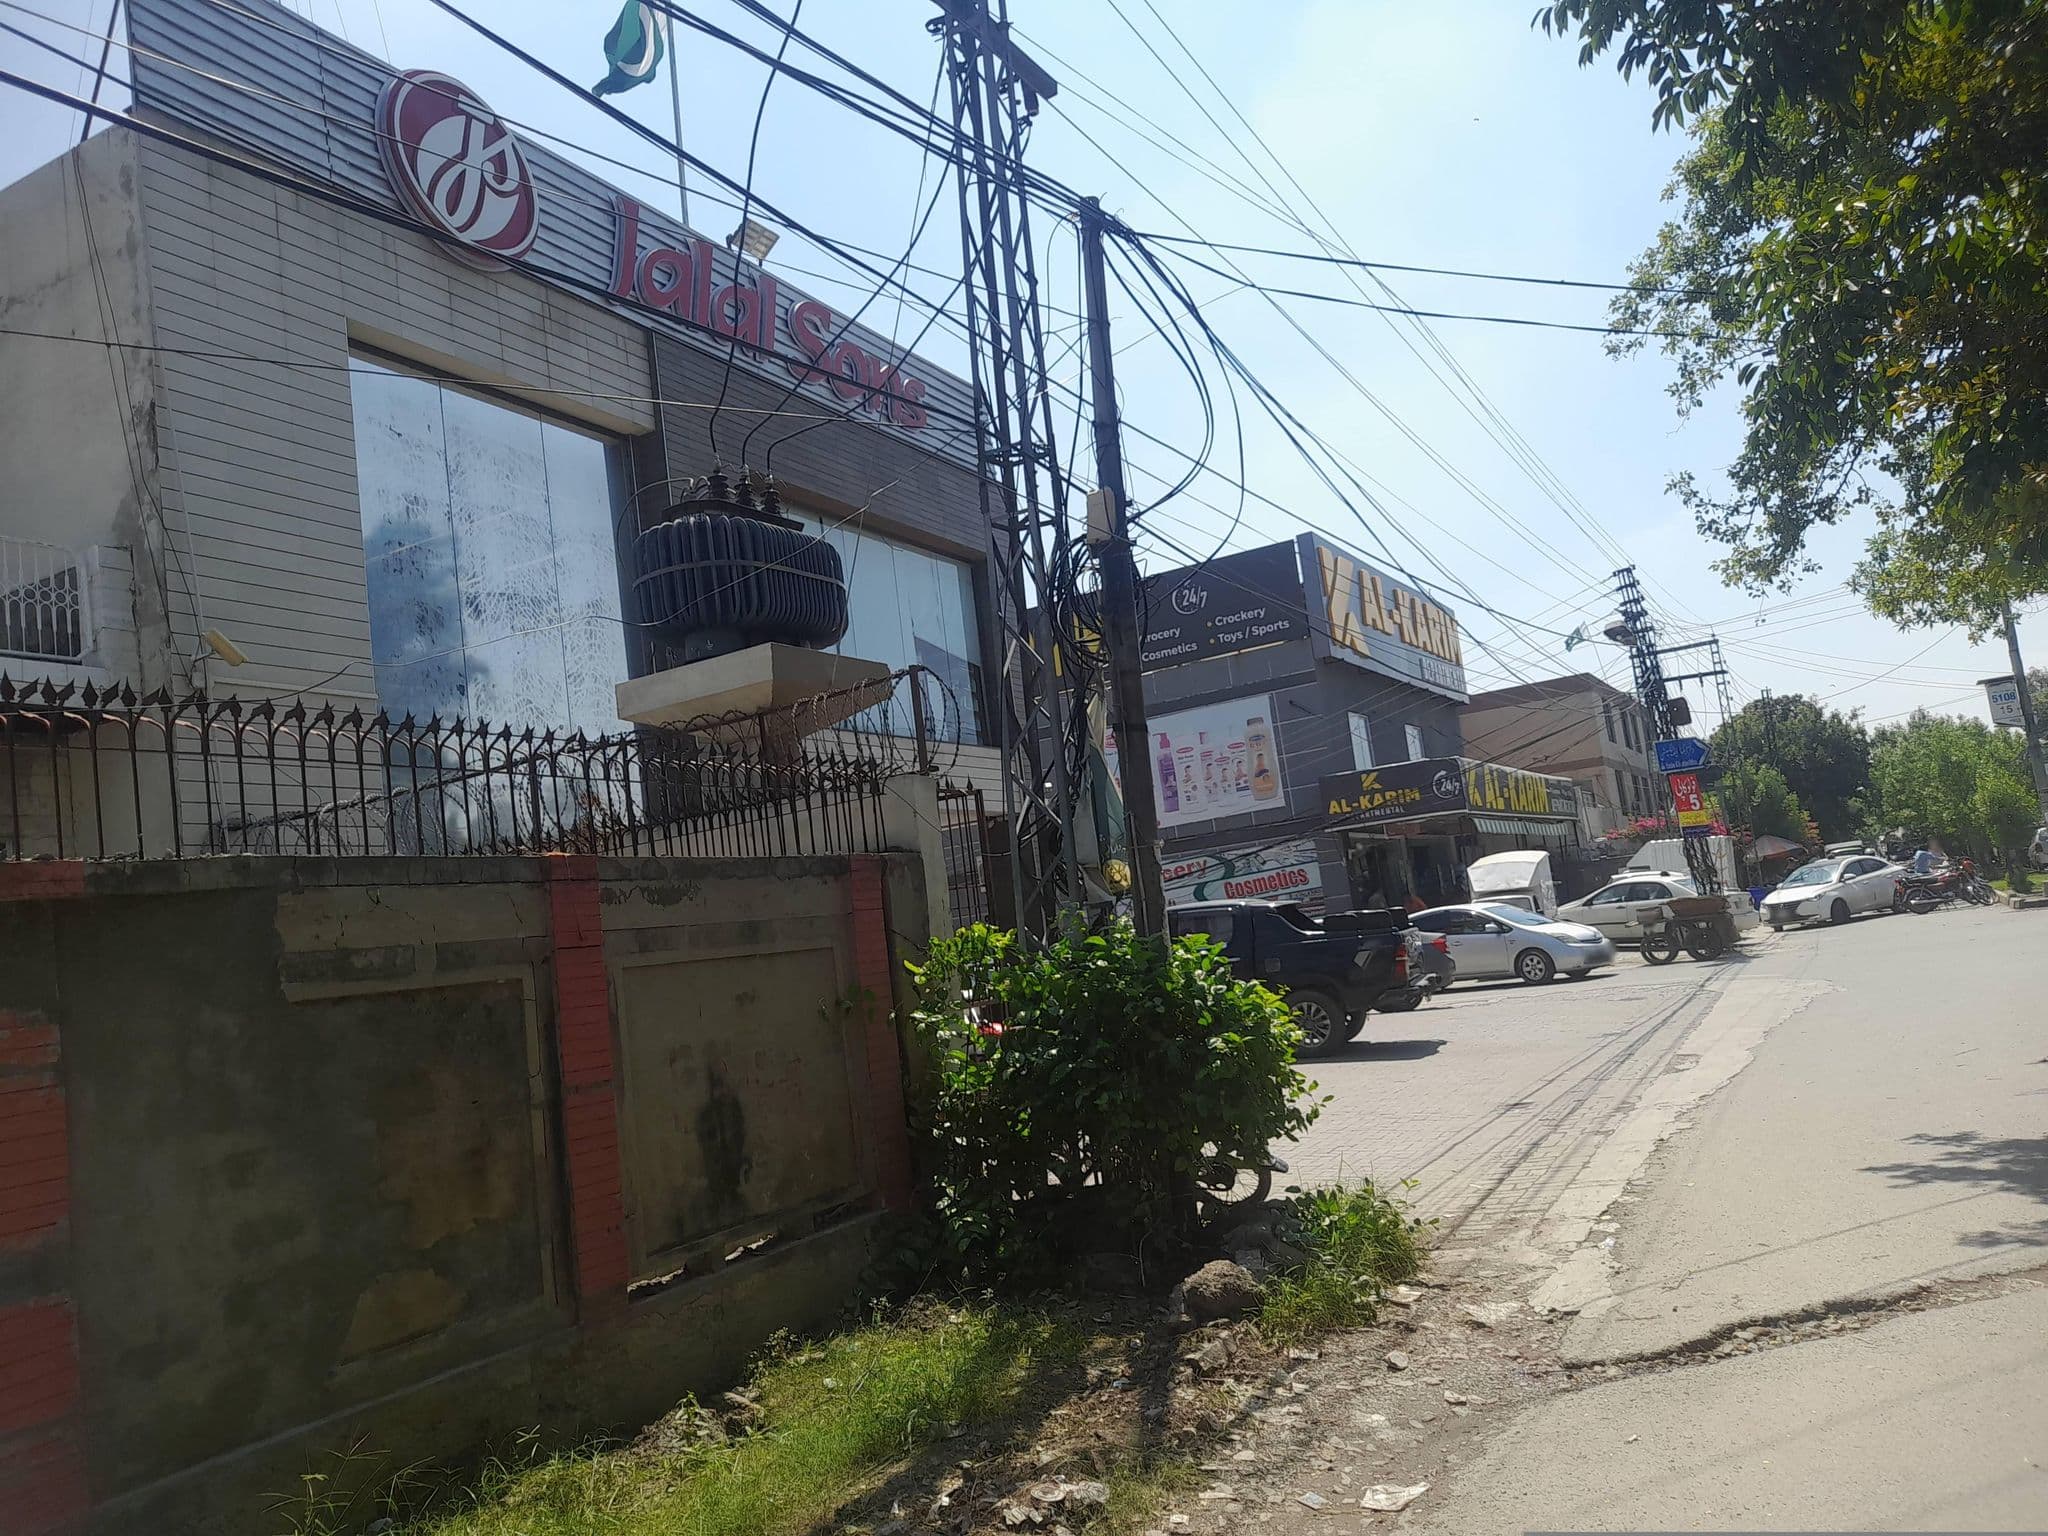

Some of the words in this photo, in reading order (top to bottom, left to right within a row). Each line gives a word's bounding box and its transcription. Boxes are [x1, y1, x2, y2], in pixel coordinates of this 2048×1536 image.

[786, 299, 927, 430] Sons
[1182, 585, 1207, 609] 24/7
[1215, 606, 1267, 626] Crockery
[1359, 568, 1464, 667] AL-KARIM
[1217, 629, 1244, 644] Toys
[1251, 619, 1290, 640] Sports
[1141, 641, 1199, 662] Cosmetics
[1992, 692, 2016, 703] 5108
[1440, 776, 1460, 797] 24/7
[1484, 765, 1550, 813] AL-KARIM
[1328, 788, 1421, 815] AL-KARIM
[1347, 805, 1404, 822] ARTMENTAL
[1162, 859, 1207, 880] cery
[1224, 867, 1310, 900] Cosmetics
